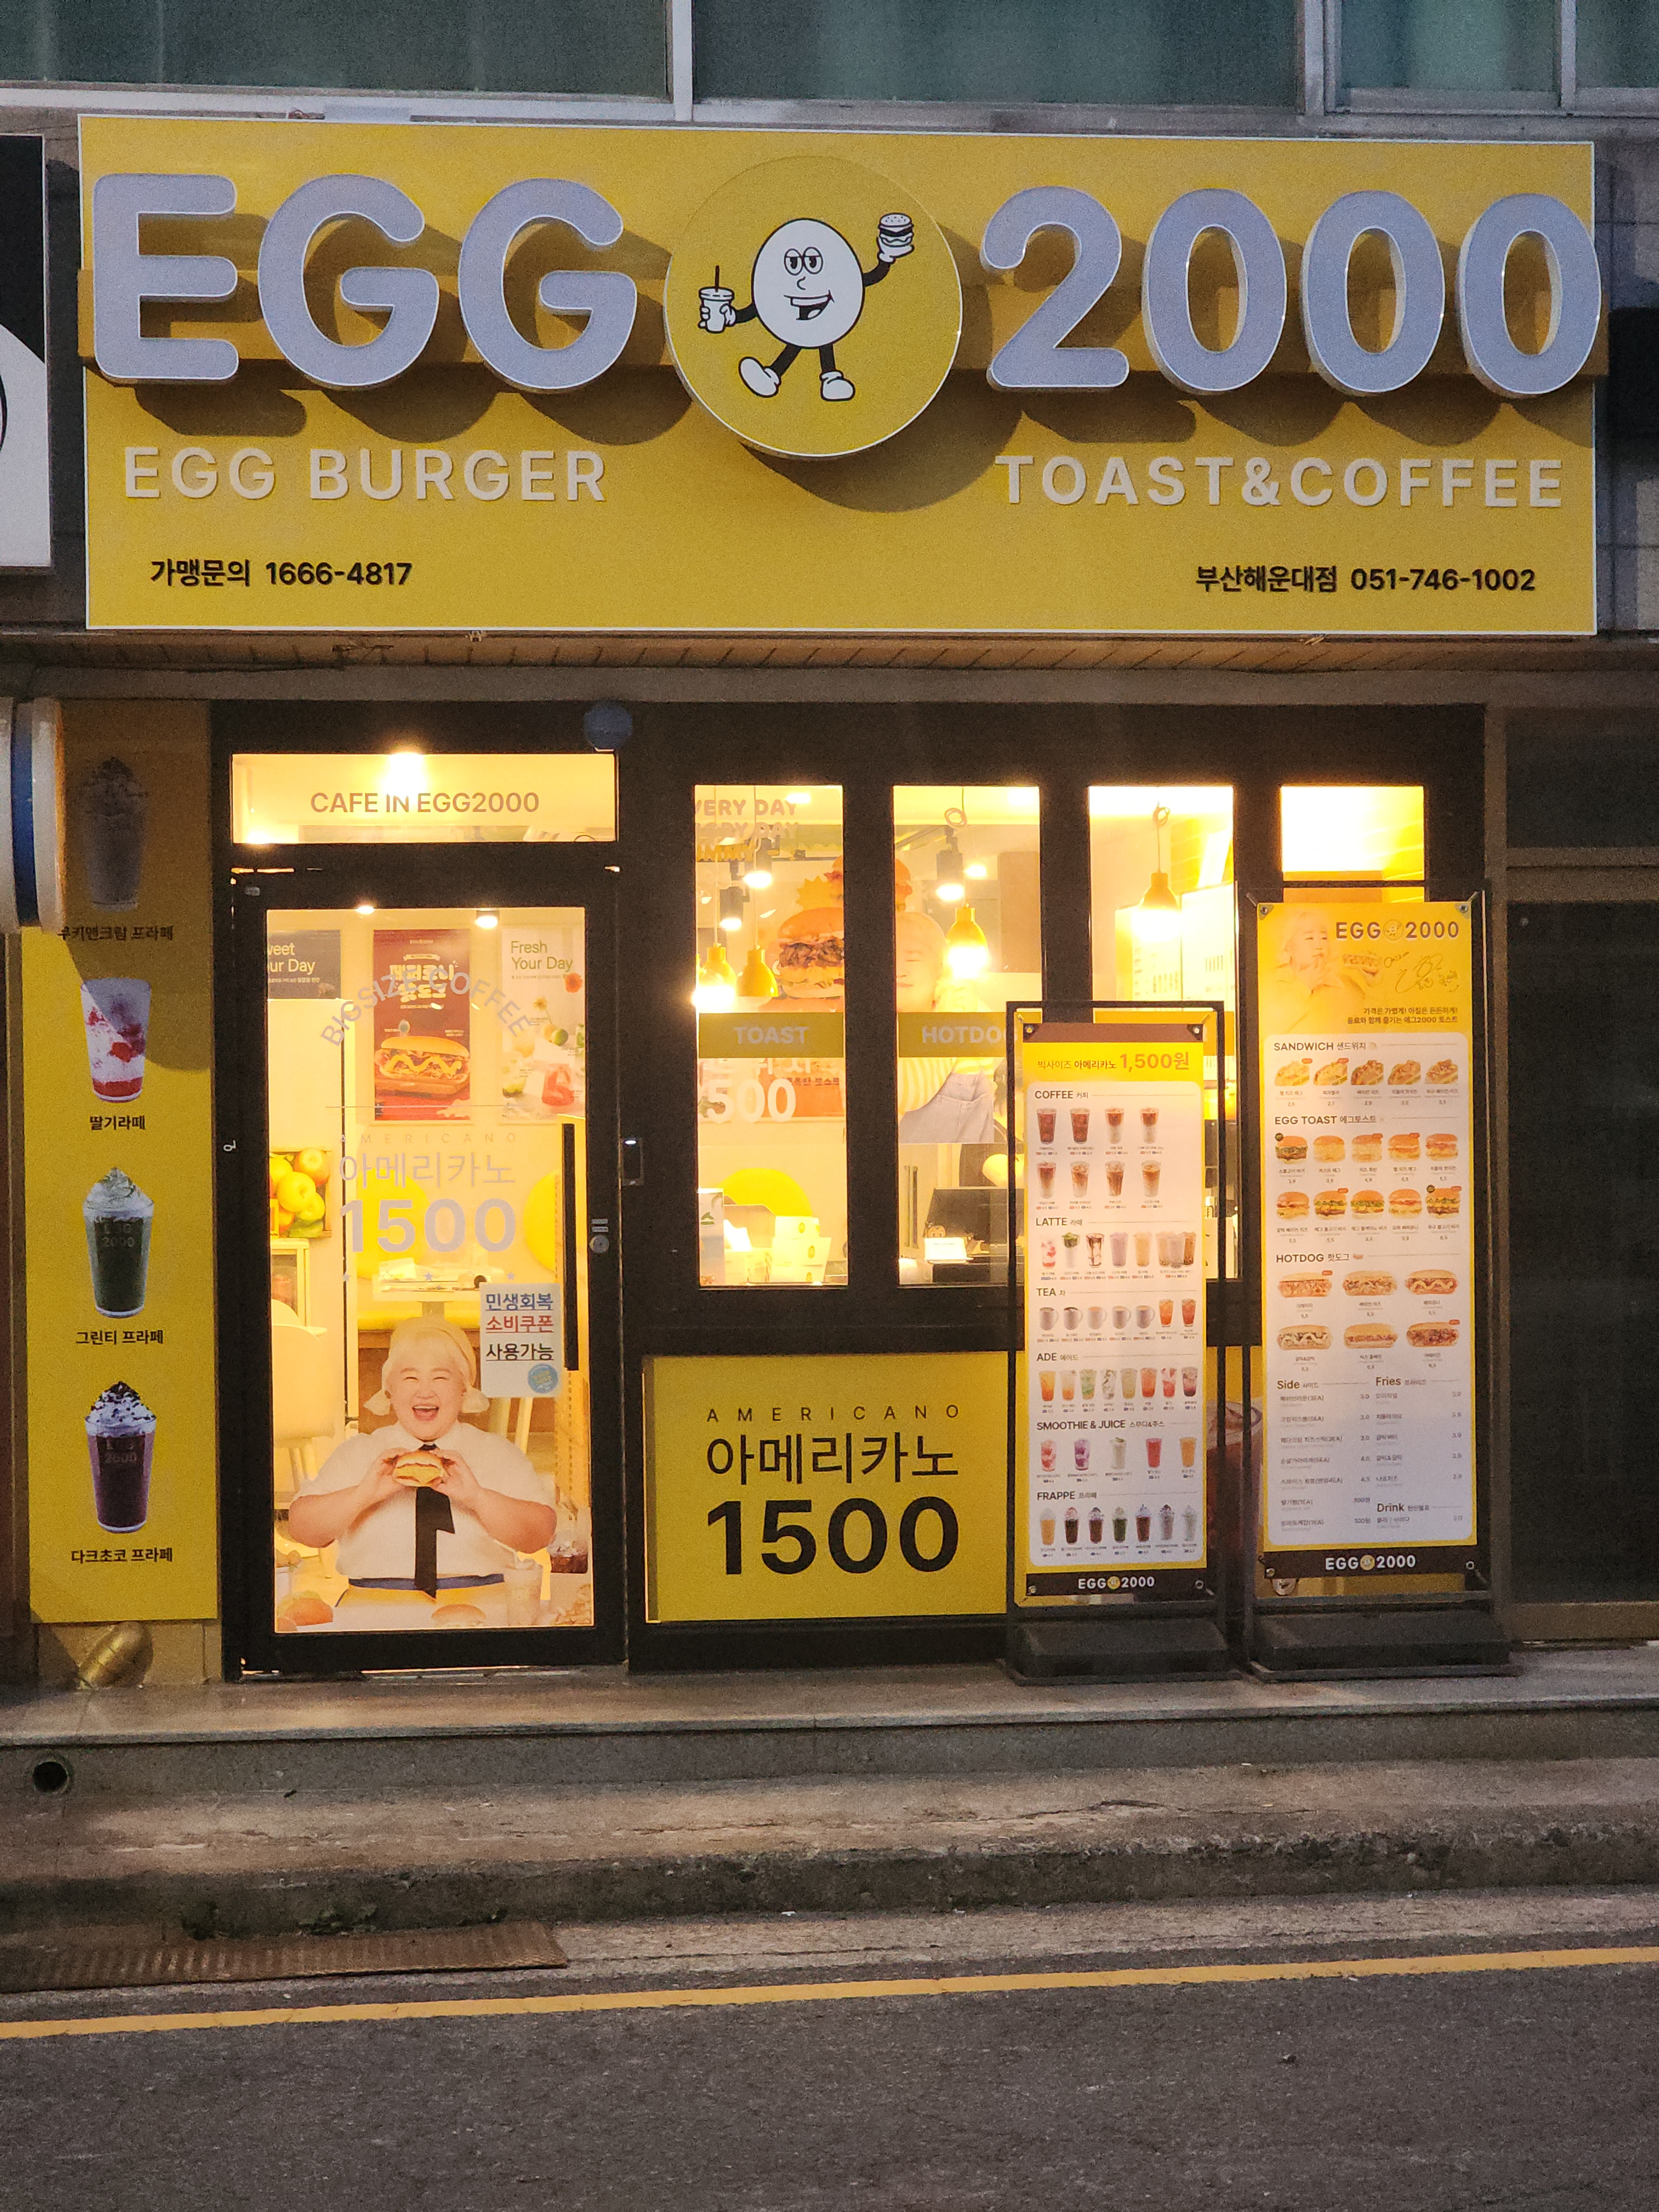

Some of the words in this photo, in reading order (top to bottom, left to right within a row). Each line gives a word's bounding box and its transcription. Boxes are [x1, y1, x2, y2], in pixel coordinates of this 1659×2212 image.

[93, 173, 638, 392] EGG
[981, 186, 1602, 397] 2000
[123, 445, 278, 500] EGG
[311, 448, 606, 503] BURGER
[995, 454, 1564, 508] TOAST&COFFEE
[150, 557, 251, 587] 가맹문의
[265, 559, 413, 587] 1666-4817
[1196, 564, 1337, 593] 부산해운대점
[1351, 567, 1535, 592] 051-746-1002
[310, 792, 378, 813] CAFE
[385, 792, 410, 813] IN
[418, 792, 540, 813] EGG2000
[755, 799, 796, 816] DAY
[131, 925, 174, 941] 프라페
[1336, 922, 1381, 940] EGG
[1405, 921, 1459, 939] 2000
[510, 940, 547, 953] Fresh
[288, 959, 316, 975] Day
[512, 956, 542, 970] Your
[546, 956, 573, 972] Day
[429, 967, 533, 1037] COFFEE
[734, 1026, 808, 1045] TOAST
[1274, 1042, 1334, 1051] SANDWICH
[1336, 1041, 1366, 1051] 샌드위치
[1037, 1060, 1072, 1070] 빅사이즈
[1074, 1059, 1117, 1070] 아메리카노
[1119, 1052, 1190, 1072] 1,500원
[1035, 1090, 1073, 1099] COFFEE
[90, 1115, 146, 1131] 딸기라떼
[1275, 1116, 1298, 1125] EGG
[1301, 1115, 1337, 1125] TOAST
[340, 1133, 517, 1144] AMERICANO
[340, 1153, 516, 1188] 아메리카노
[340, 1198, 517, 1253] 1500
[1036, 1217, 1067, 1227] LATTE
[1276, 1253, 1324, 1263] HOTDOG
[1327, 1253, 1350, 1262] 핫도그
[1036, 1288, 1056, 1297] TEA
[486, 1293, 553, 1311] 민생회복
[486, 1315, 554, 1333] 소비쿠폰
[76, 1329, 118, 1345] 그린티
[122, 1329, 164, 1345] 프라페
[486, 1343, 554, 1360] 사용가능
[1037, 1352, 1057, 1361] ADE
[1277, 1380, 1300, 1389] Side
[1376, 1376, 1401, 1386] Fries
[707, 1404, 959, 1422] AMERICANO
[1037, 1421, 1088, 1431] SMOOTHIE
[1090, 1420, 1097, 1430] &
[1098, 1420, 1126, 1429] JUICE
[707, 1432, 959, 1485] 아메리카노
[1037, 1491, 1076, 1500] FRAPPE
[1377, 1503, 1405, 1512] Drink
[707, 1496, 959, 1575] 1500
[71, 1548, 127, 1564] 다크초코
[131, 1547, 173, 1563] 프라페
[1325, 1557, 1358, 1571] EGG
[1376, 1555, 1416, 1568] 2000
[1078, 1578, 1107, 1589] EGG
[1121, 1576, 1155, 1589] 2000
